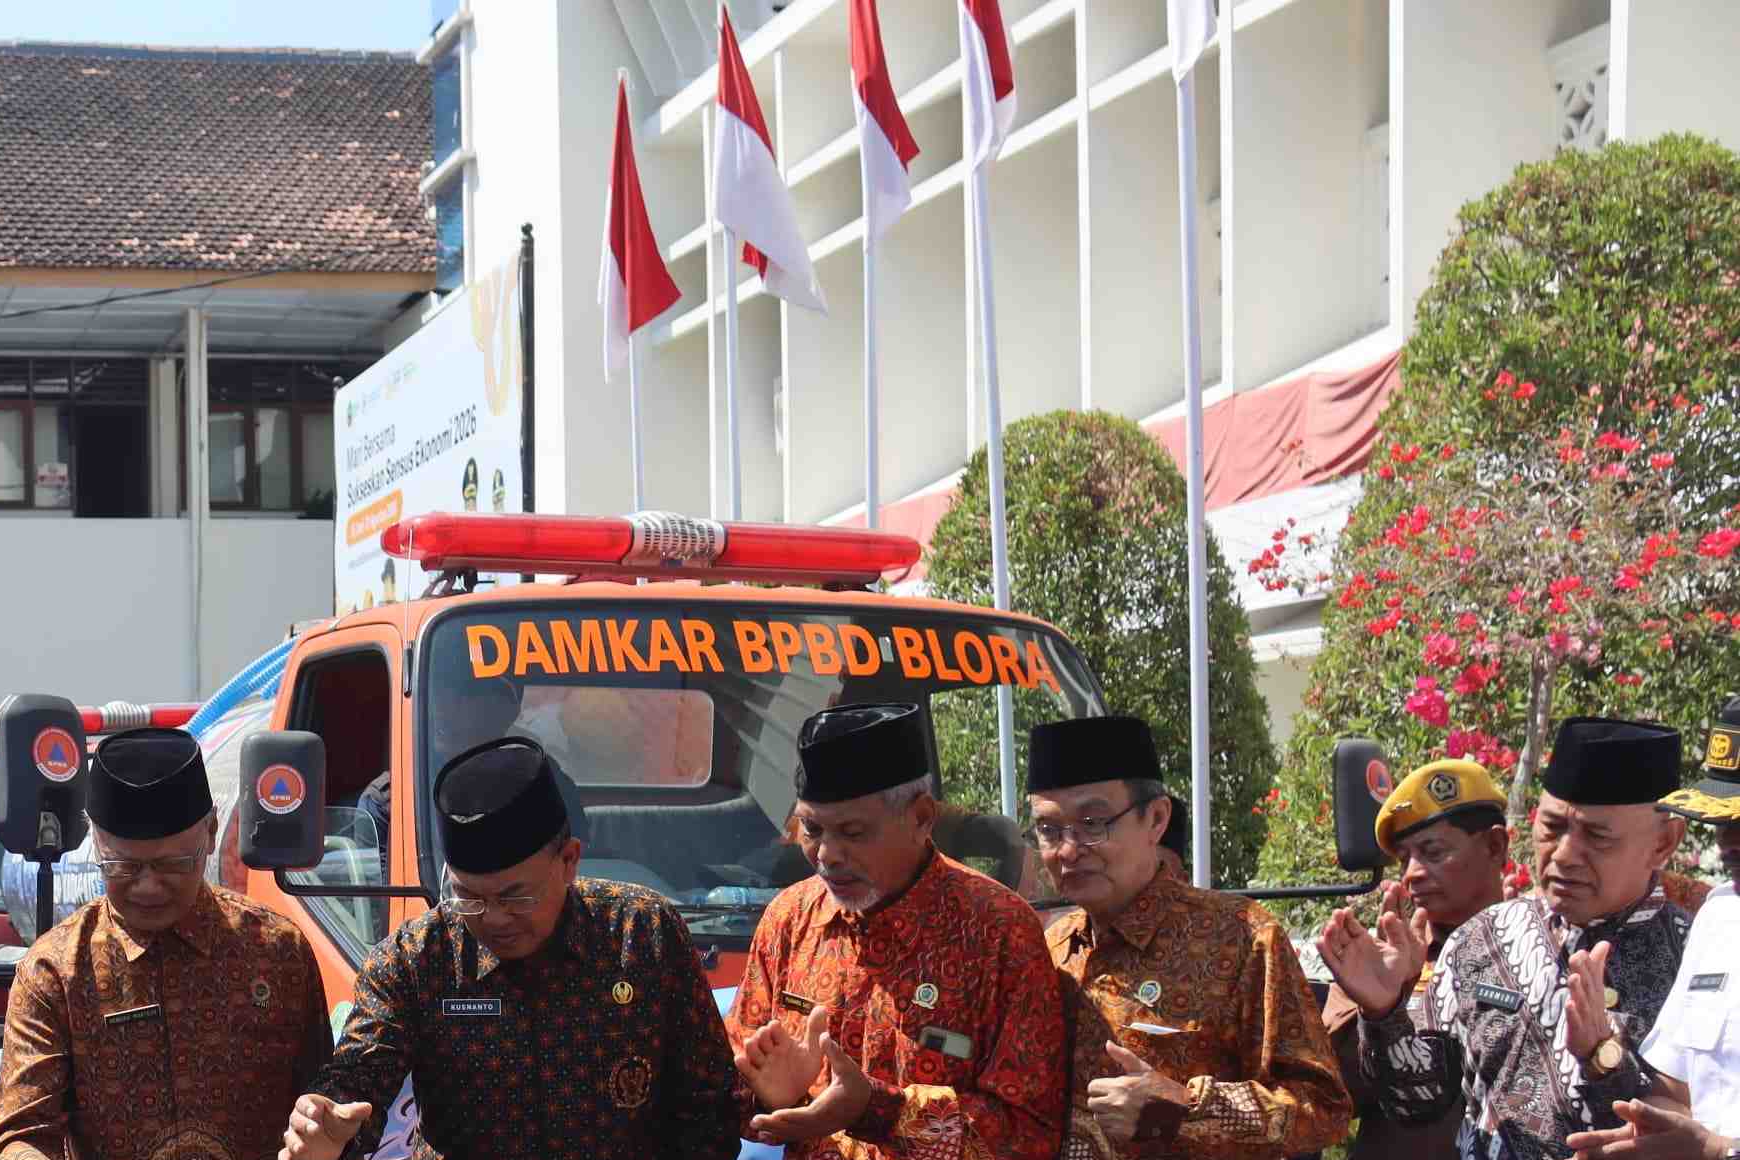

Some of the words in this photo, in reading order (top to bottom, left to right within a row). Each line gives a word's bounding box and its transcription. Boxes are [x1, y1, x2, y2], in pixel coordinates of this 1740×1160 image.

[347, 468, 385, 508] Sukseskan
[386, 450, 414, 485] Sensus
[415, 422, 453, 467] Ekonomi
[453, 404, 477, 445] 2026
[363, 424, 396, 461] Bersama
[466, 618, 725, 678] DAMKAR
[733, 620, 881, 677] BPBD
[891, 626, 1061, 693] BLORA
[450, 1003, 494, 1011] KUSNANTO
